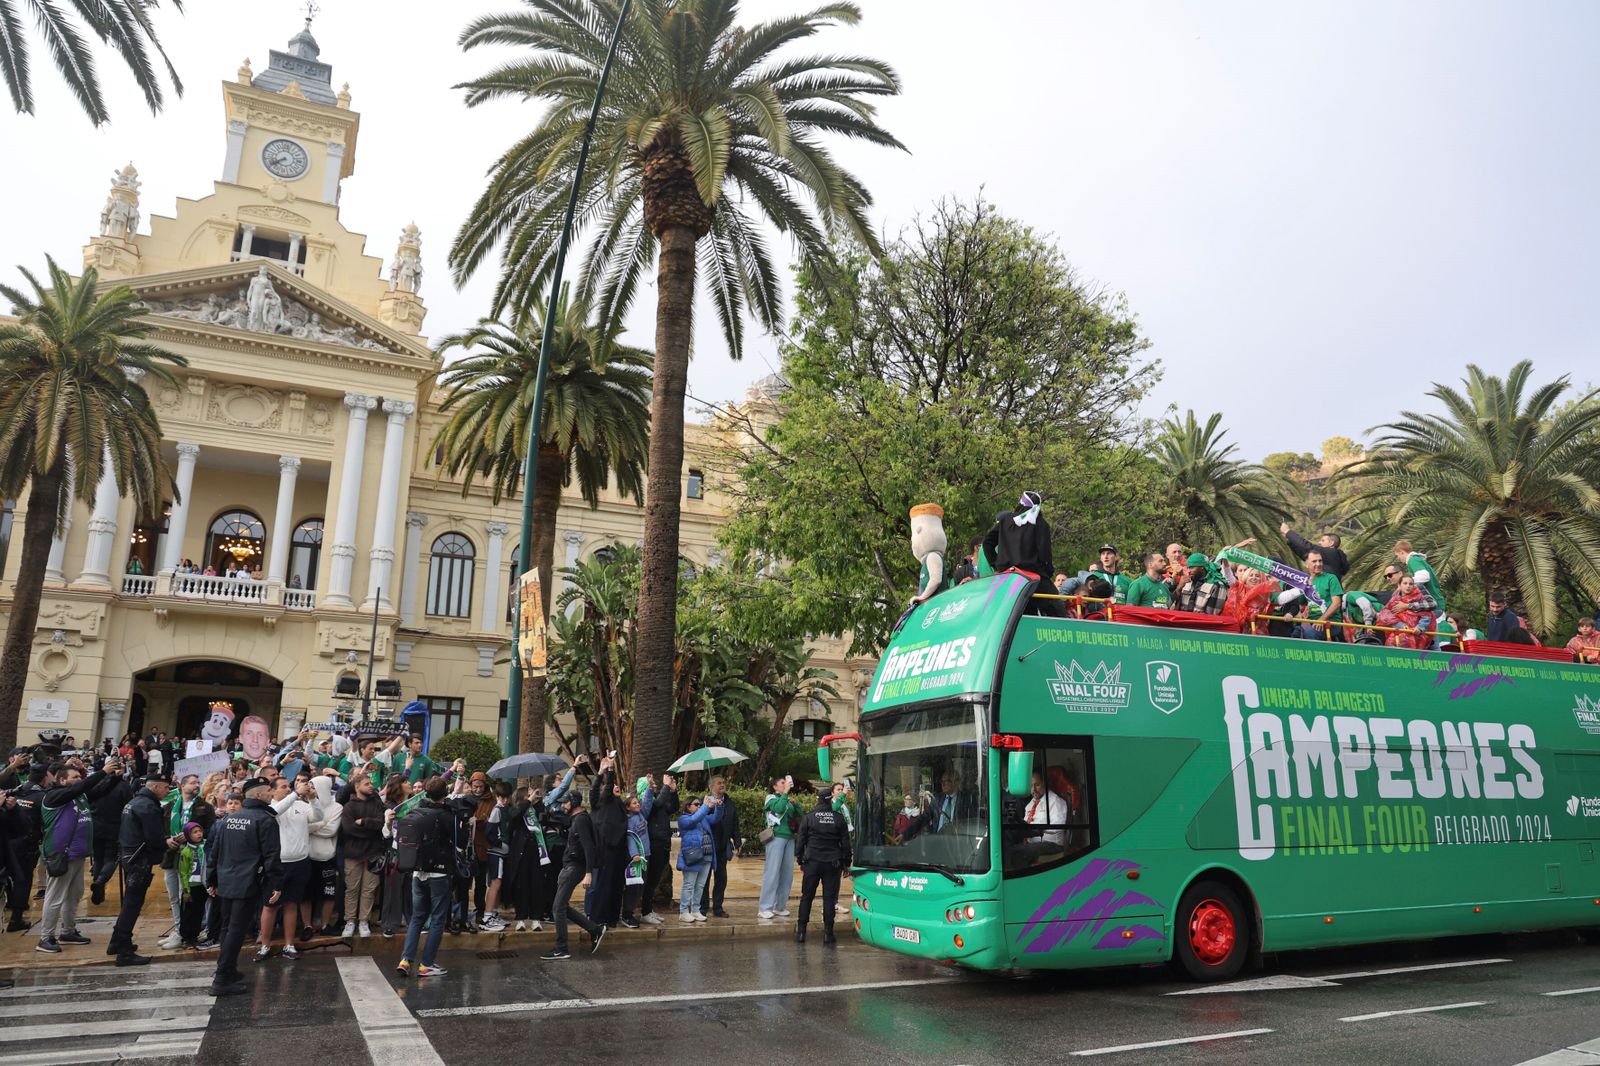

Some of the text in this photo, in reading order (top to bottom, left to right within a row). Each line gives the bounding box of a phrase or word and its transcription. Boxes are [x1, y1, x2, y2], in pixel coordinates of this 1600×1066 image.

[1228, 547, 1309, 585] Unicaja Baloncest
[1036, 628, 1073, 643] UNICAJA
[1077, 631, 1129, 648] BALONCESTO
[1137, 634, 1164, 650] MÁLAGA
[1169, 638, 1201, 653] UNICAJA
[1203, 641, 1250, 656] BALONCESTO
[1256, 644, 1280, 659] MÁLAGA
[1284, 648, 1313, 662] UNICAJA
[1314, 651, 1356, 665] BALONCESTO
[872, 636, 977, 703] CAMPEONES
[901, 676, 922, 696] FOUR
[1052, 683, 1127, 699] FINAL FOUR
[1262, 687, 1385, 713] UNICAJA BALONCESTO
[359, 720, 410, 737] UNICAJA
[1576, 711, 1600, 722] FINAL
[1222, 675, 1545, 861] CAMPEONES
[1281, 804, 1553, 857] FINAL FOUR BELGRADO 2024
[882, 877, 898, 889] Unicaja
